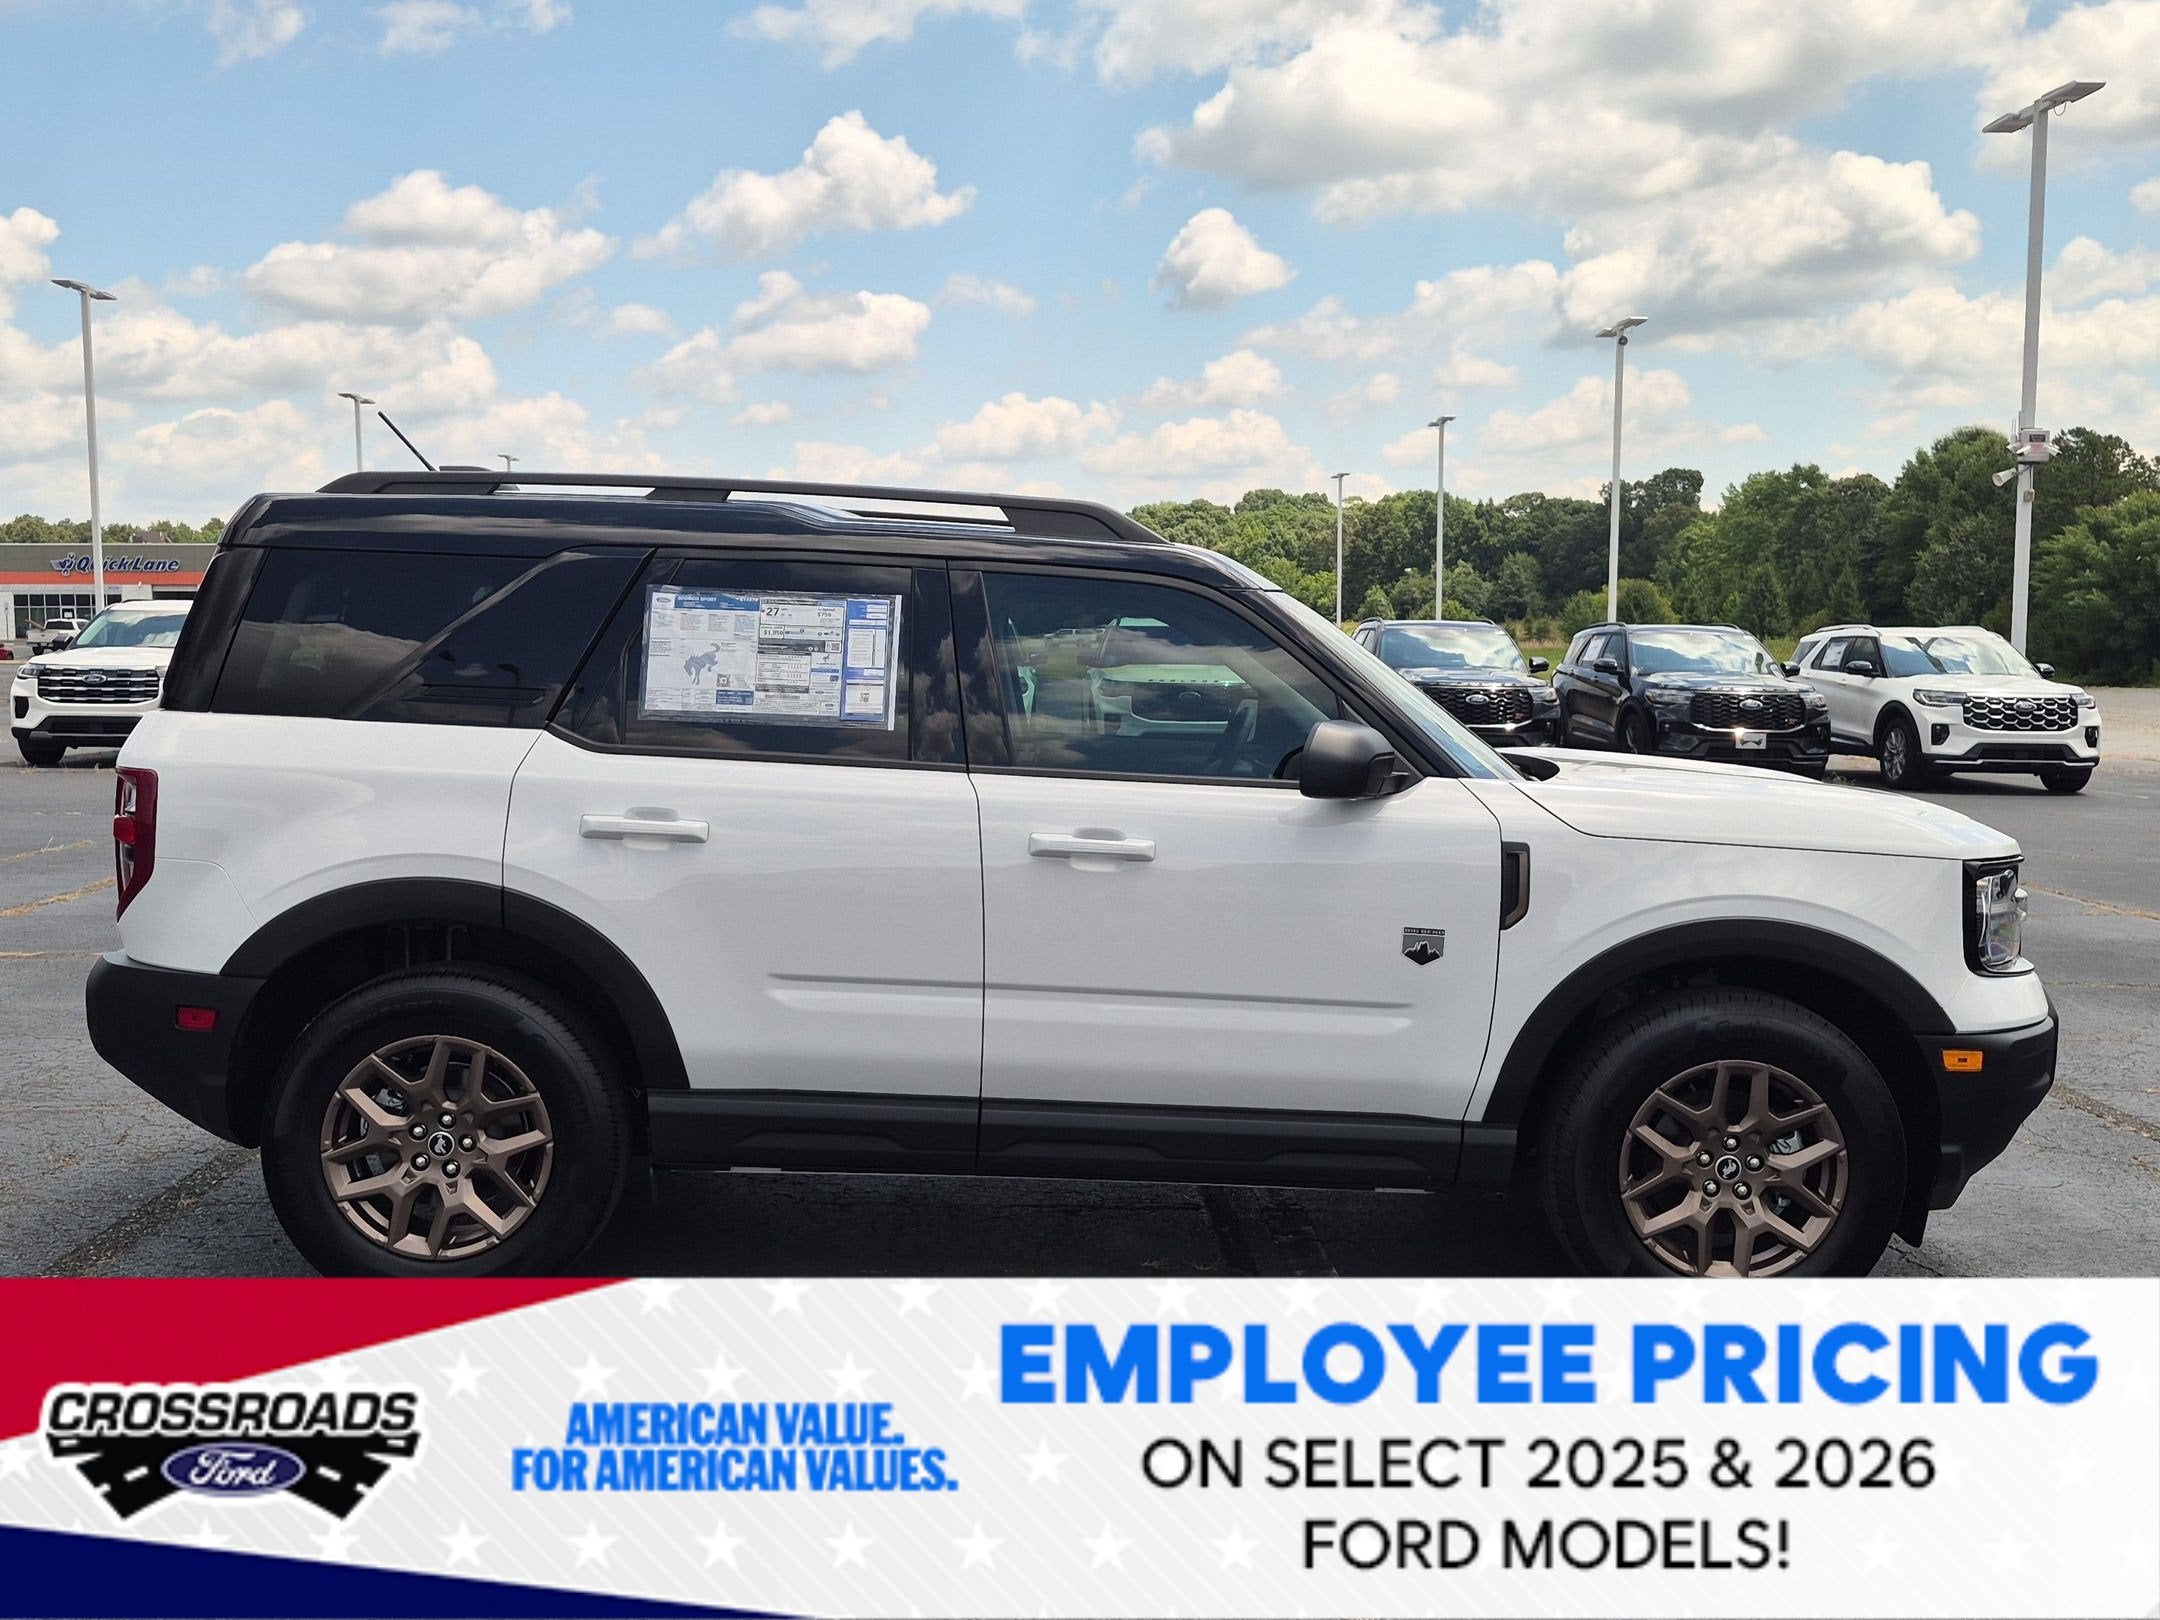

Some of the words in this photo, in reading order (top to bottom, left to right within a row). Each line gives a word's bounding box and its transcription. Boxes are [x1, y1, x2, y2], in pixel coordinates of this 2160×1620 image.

[75, 556, 131, 572] Qick
[131, 556, 180, 571] Lane
[766, 607, 780, 616] 27
